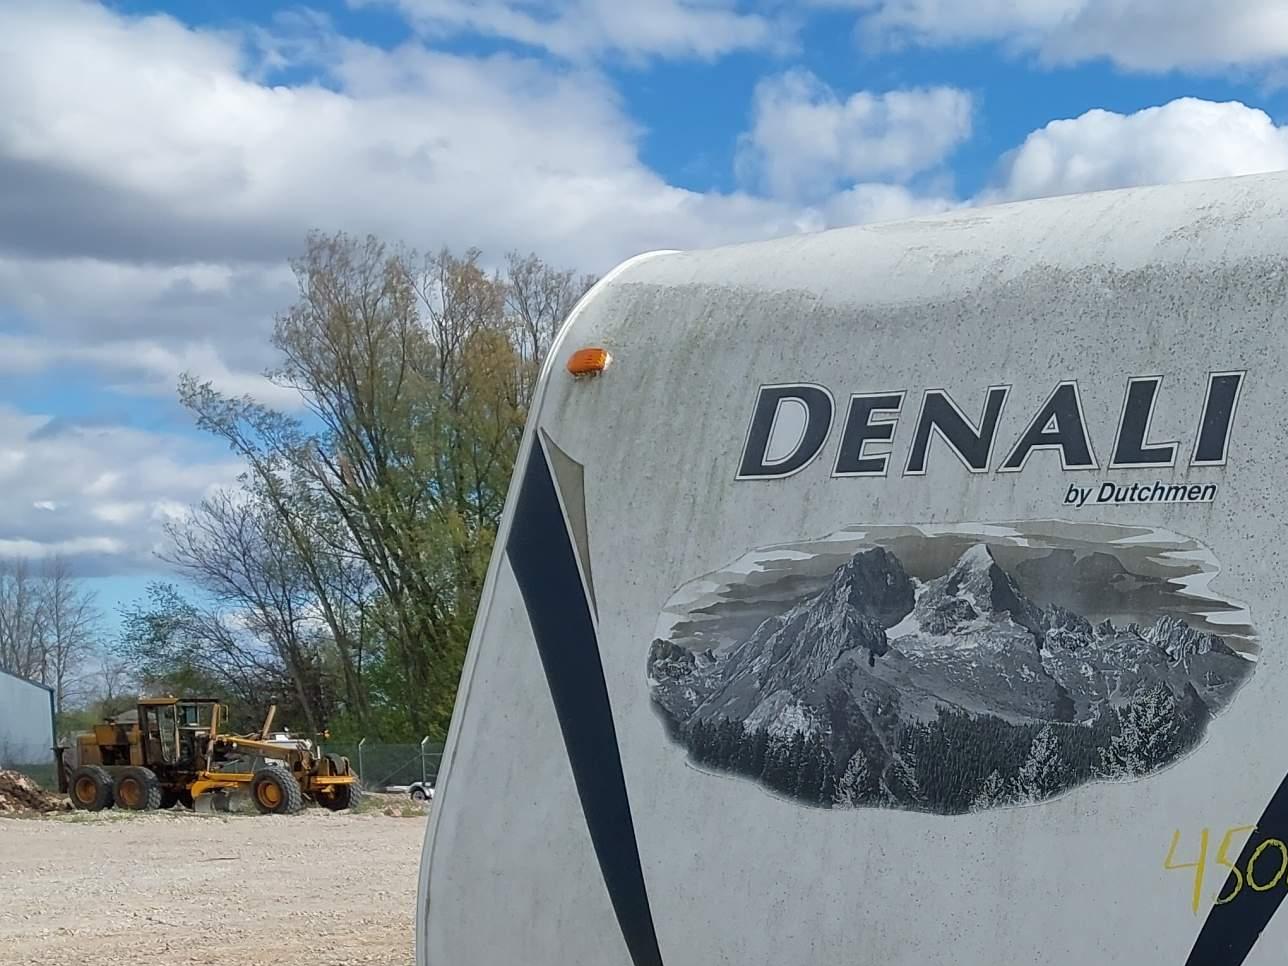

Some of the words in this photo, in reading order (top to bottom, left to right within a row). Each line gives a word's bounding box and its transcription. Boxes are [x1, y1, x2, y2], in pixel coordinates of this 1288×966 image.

[736, 371, 1247, 480] DENALI
[1064, 483, 1092, 508] by
[1096, 481, 1216, 502] Dutchmen
